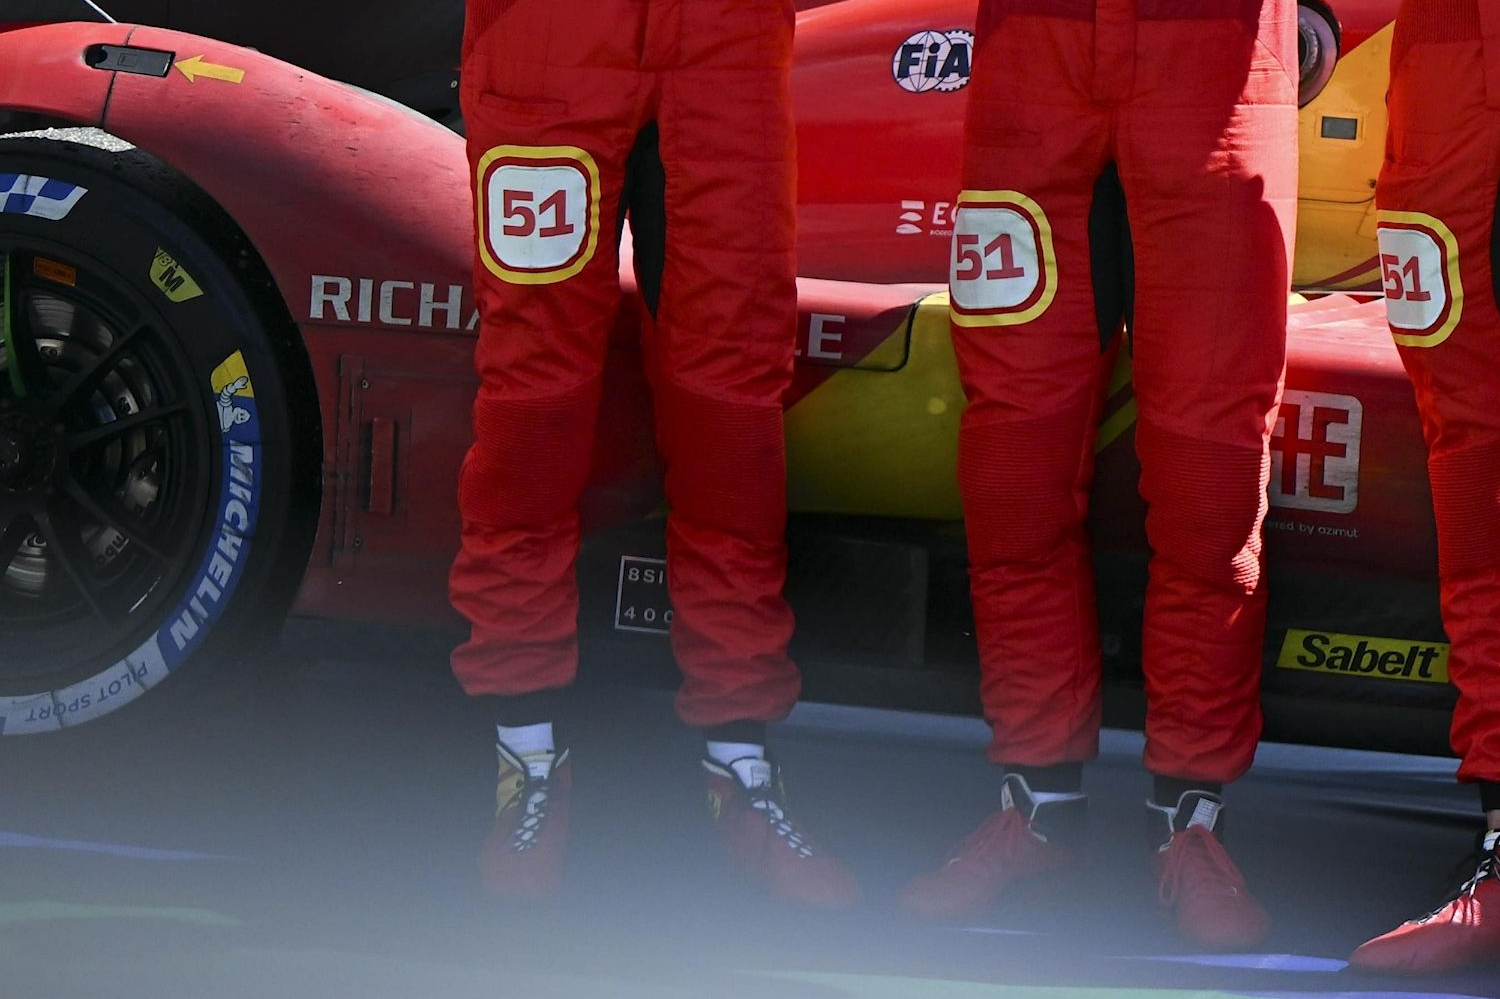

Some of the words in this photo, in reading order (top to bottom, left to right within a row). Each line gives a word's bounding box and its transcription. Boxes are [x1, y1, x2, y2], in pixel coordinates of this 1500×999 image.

[502, 188, 574, 238] 51
[956, 233, 1025, 281] 51
[1381, 253, 1431, 302] 51
[168, 439, 255, 651] MICHELIN
[1300, 521, 1314, 535] by
[1317, 525, 1358, 538] azimut
[1296, 634, 1438, 679] Sabelt
